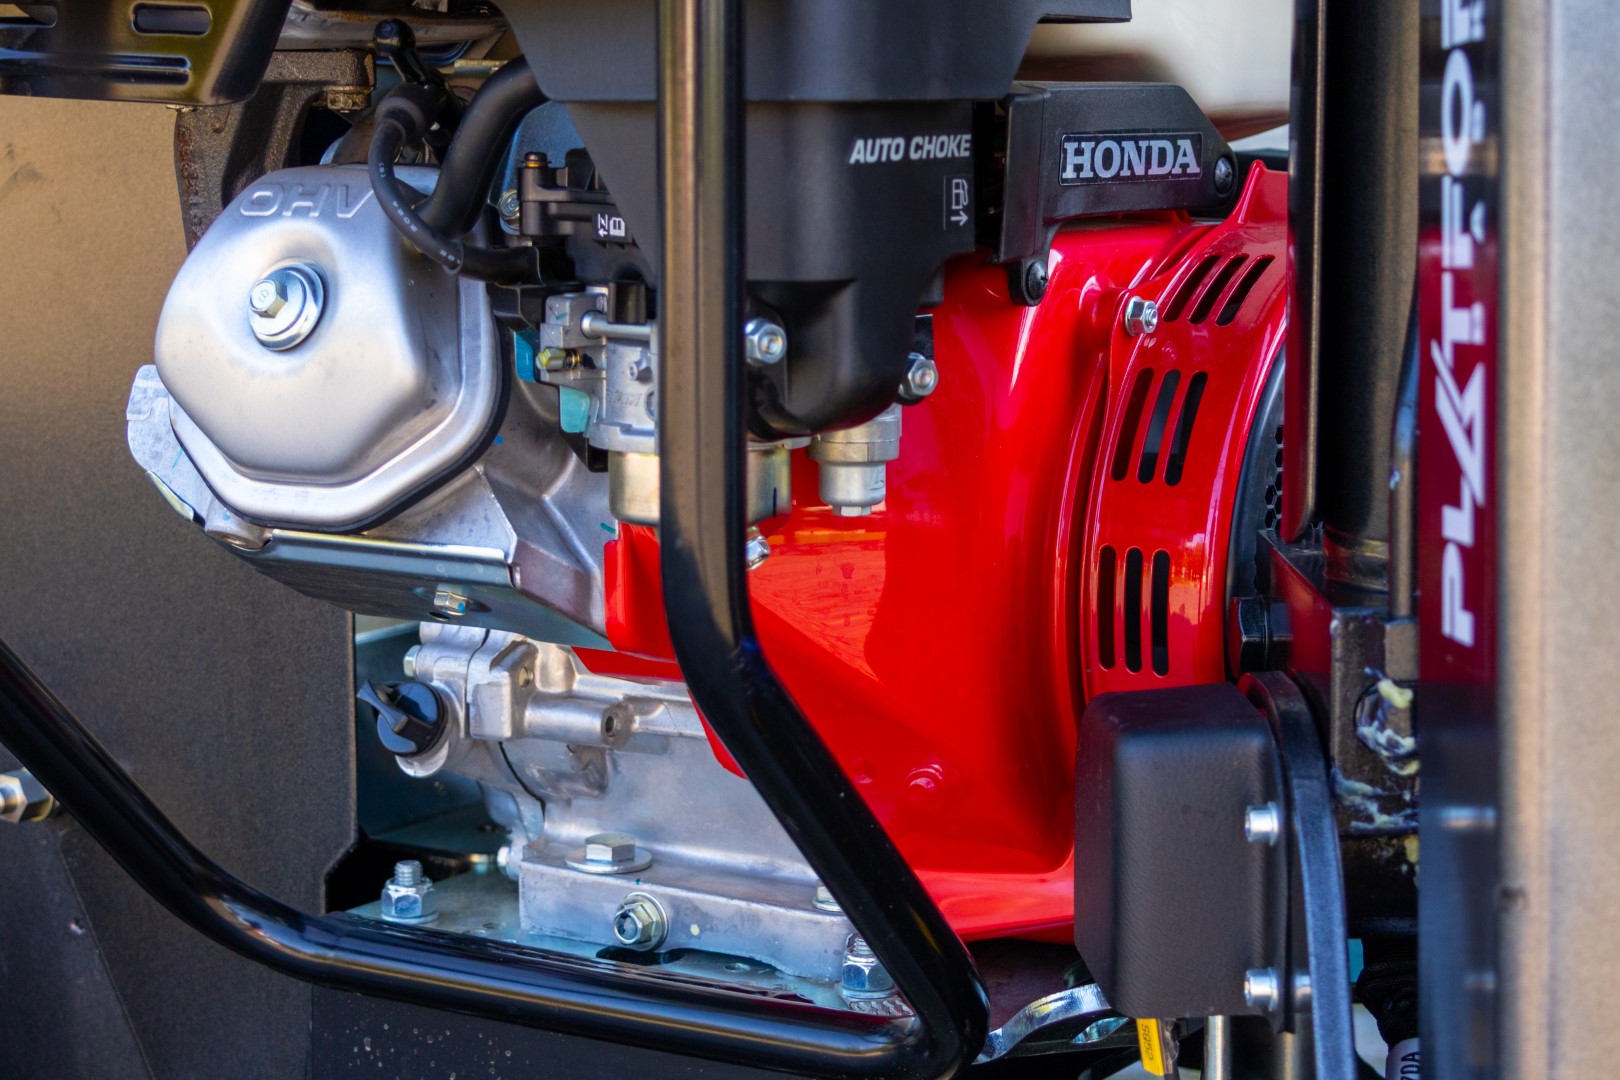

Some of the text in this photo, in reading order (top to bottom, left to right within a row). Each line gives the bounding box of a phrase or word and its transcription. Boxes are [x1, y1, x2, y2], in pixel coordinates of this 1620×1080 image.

[849, 134, 971, 164] AUTO CHOKE
[1062, 139, 1200, 179] HONDA
[240, 183, 376, 218] OHV
